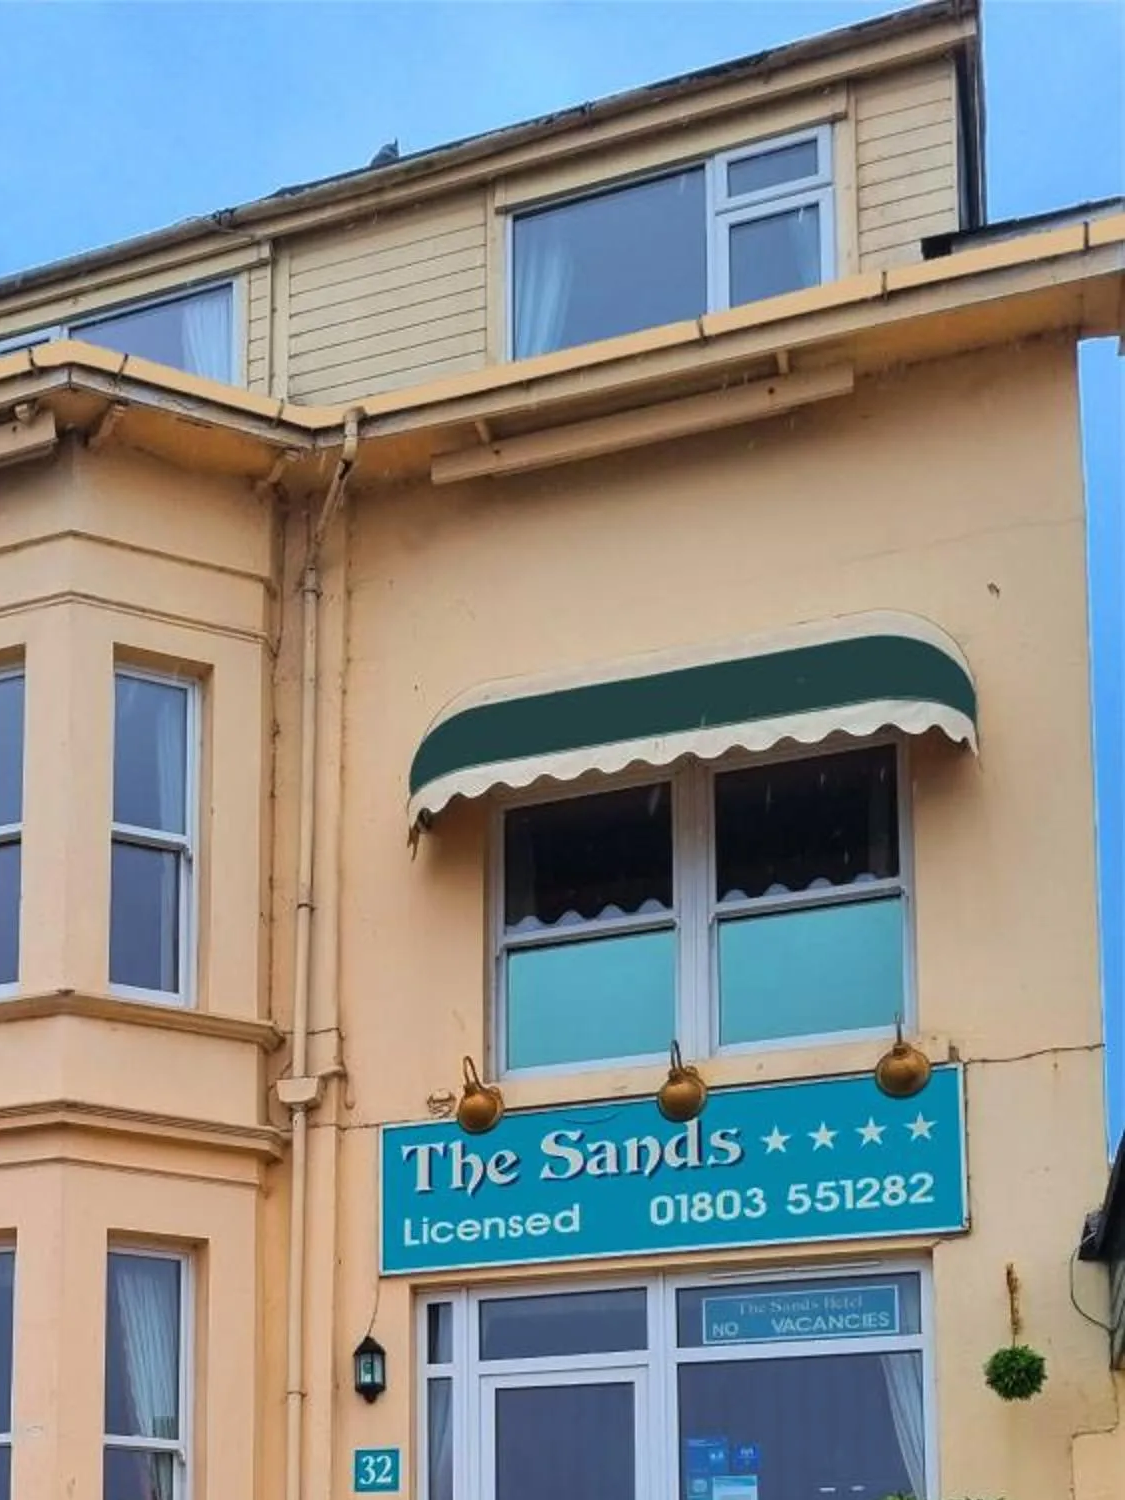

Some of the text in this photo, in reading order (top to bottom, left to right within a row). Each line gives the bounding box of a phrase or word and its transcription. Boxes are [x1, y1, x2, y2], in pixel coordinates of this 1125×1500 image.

[402, 1117, 744, 1196] The Sands
[650, 1172, 935, 1226] 01803 551282
[403, 1203, 581, 1246] Licensed
[711, 1311, 891, 1338] NO VACANCIES
[358, 1454, 393, 1485] 32
